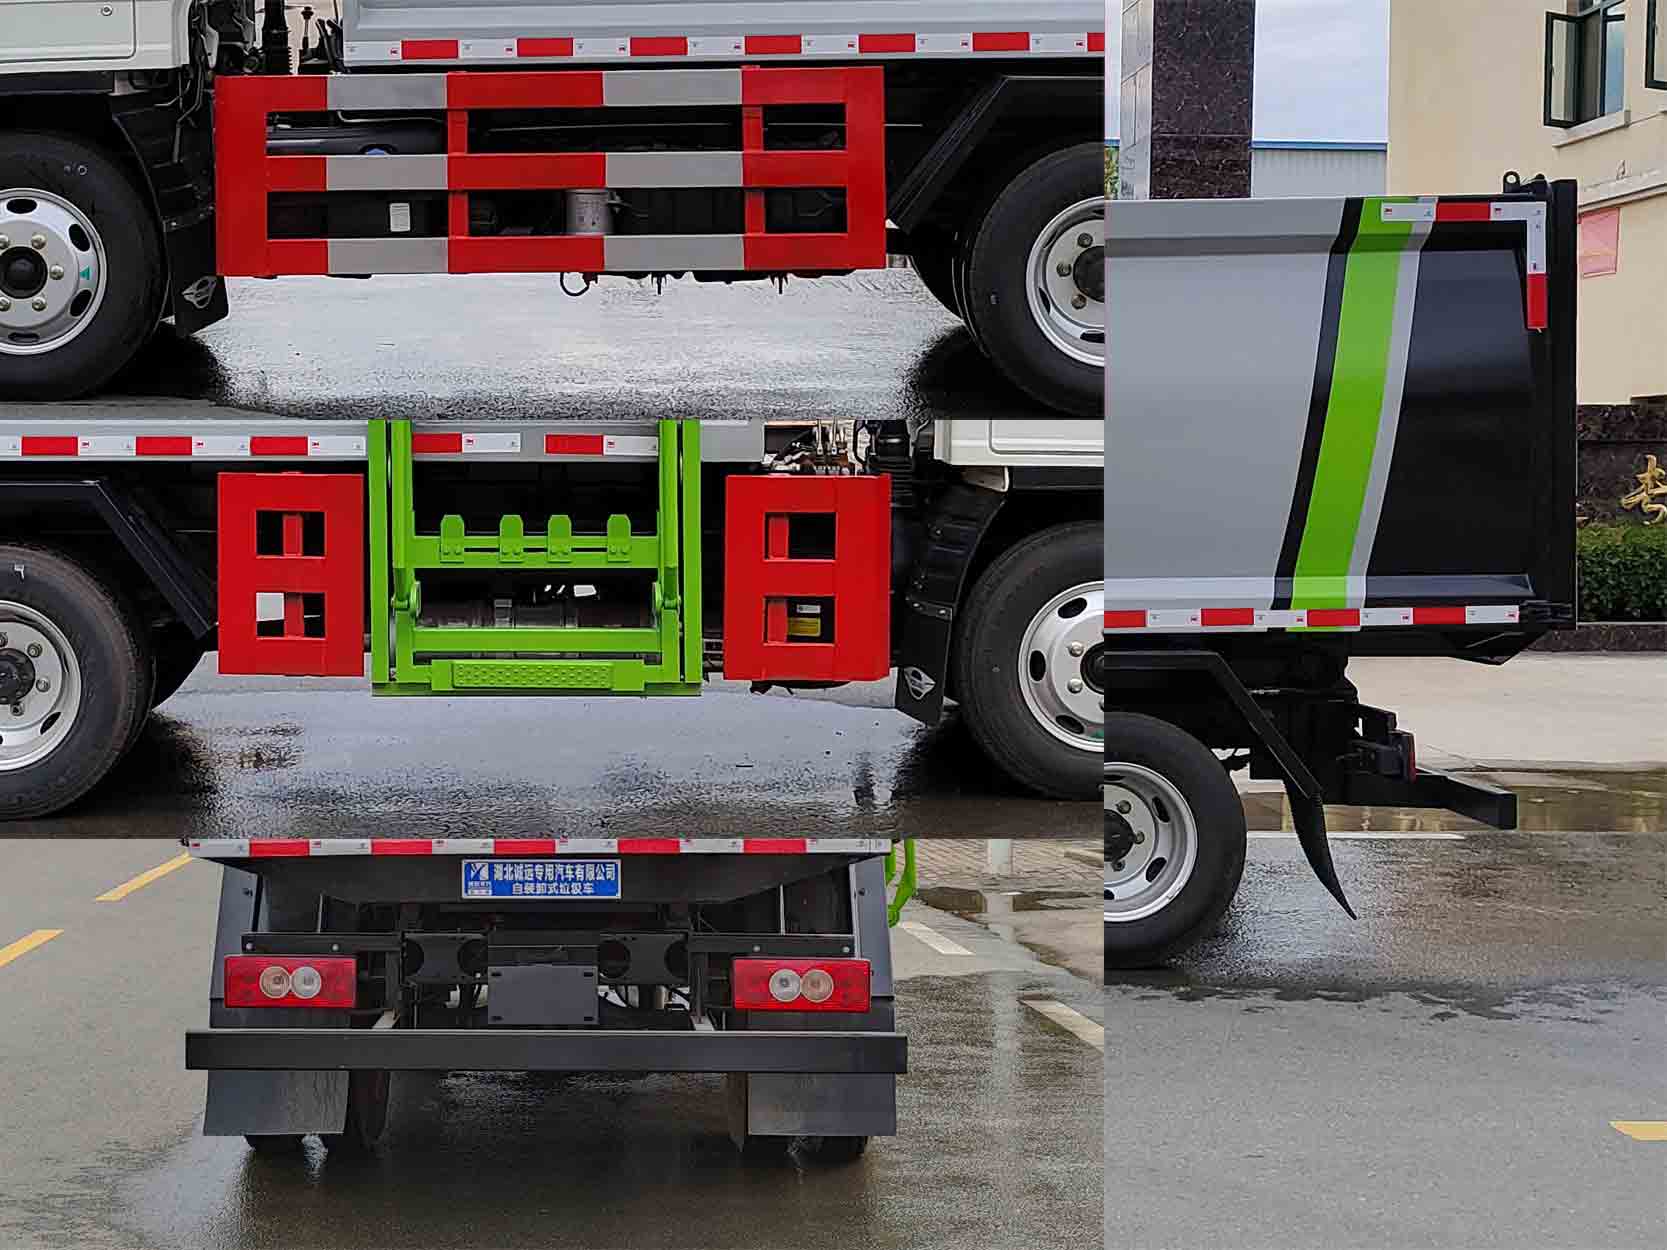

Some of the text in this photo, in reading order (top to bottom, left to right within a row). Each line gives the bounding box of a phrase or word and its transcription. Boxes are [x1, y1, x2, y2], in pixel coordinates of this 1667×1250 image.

[493, 863, 616, 881] 湖北诚远专用汽车有限公司
[512, 882, 595, 895] 自装卸式垃圾车
